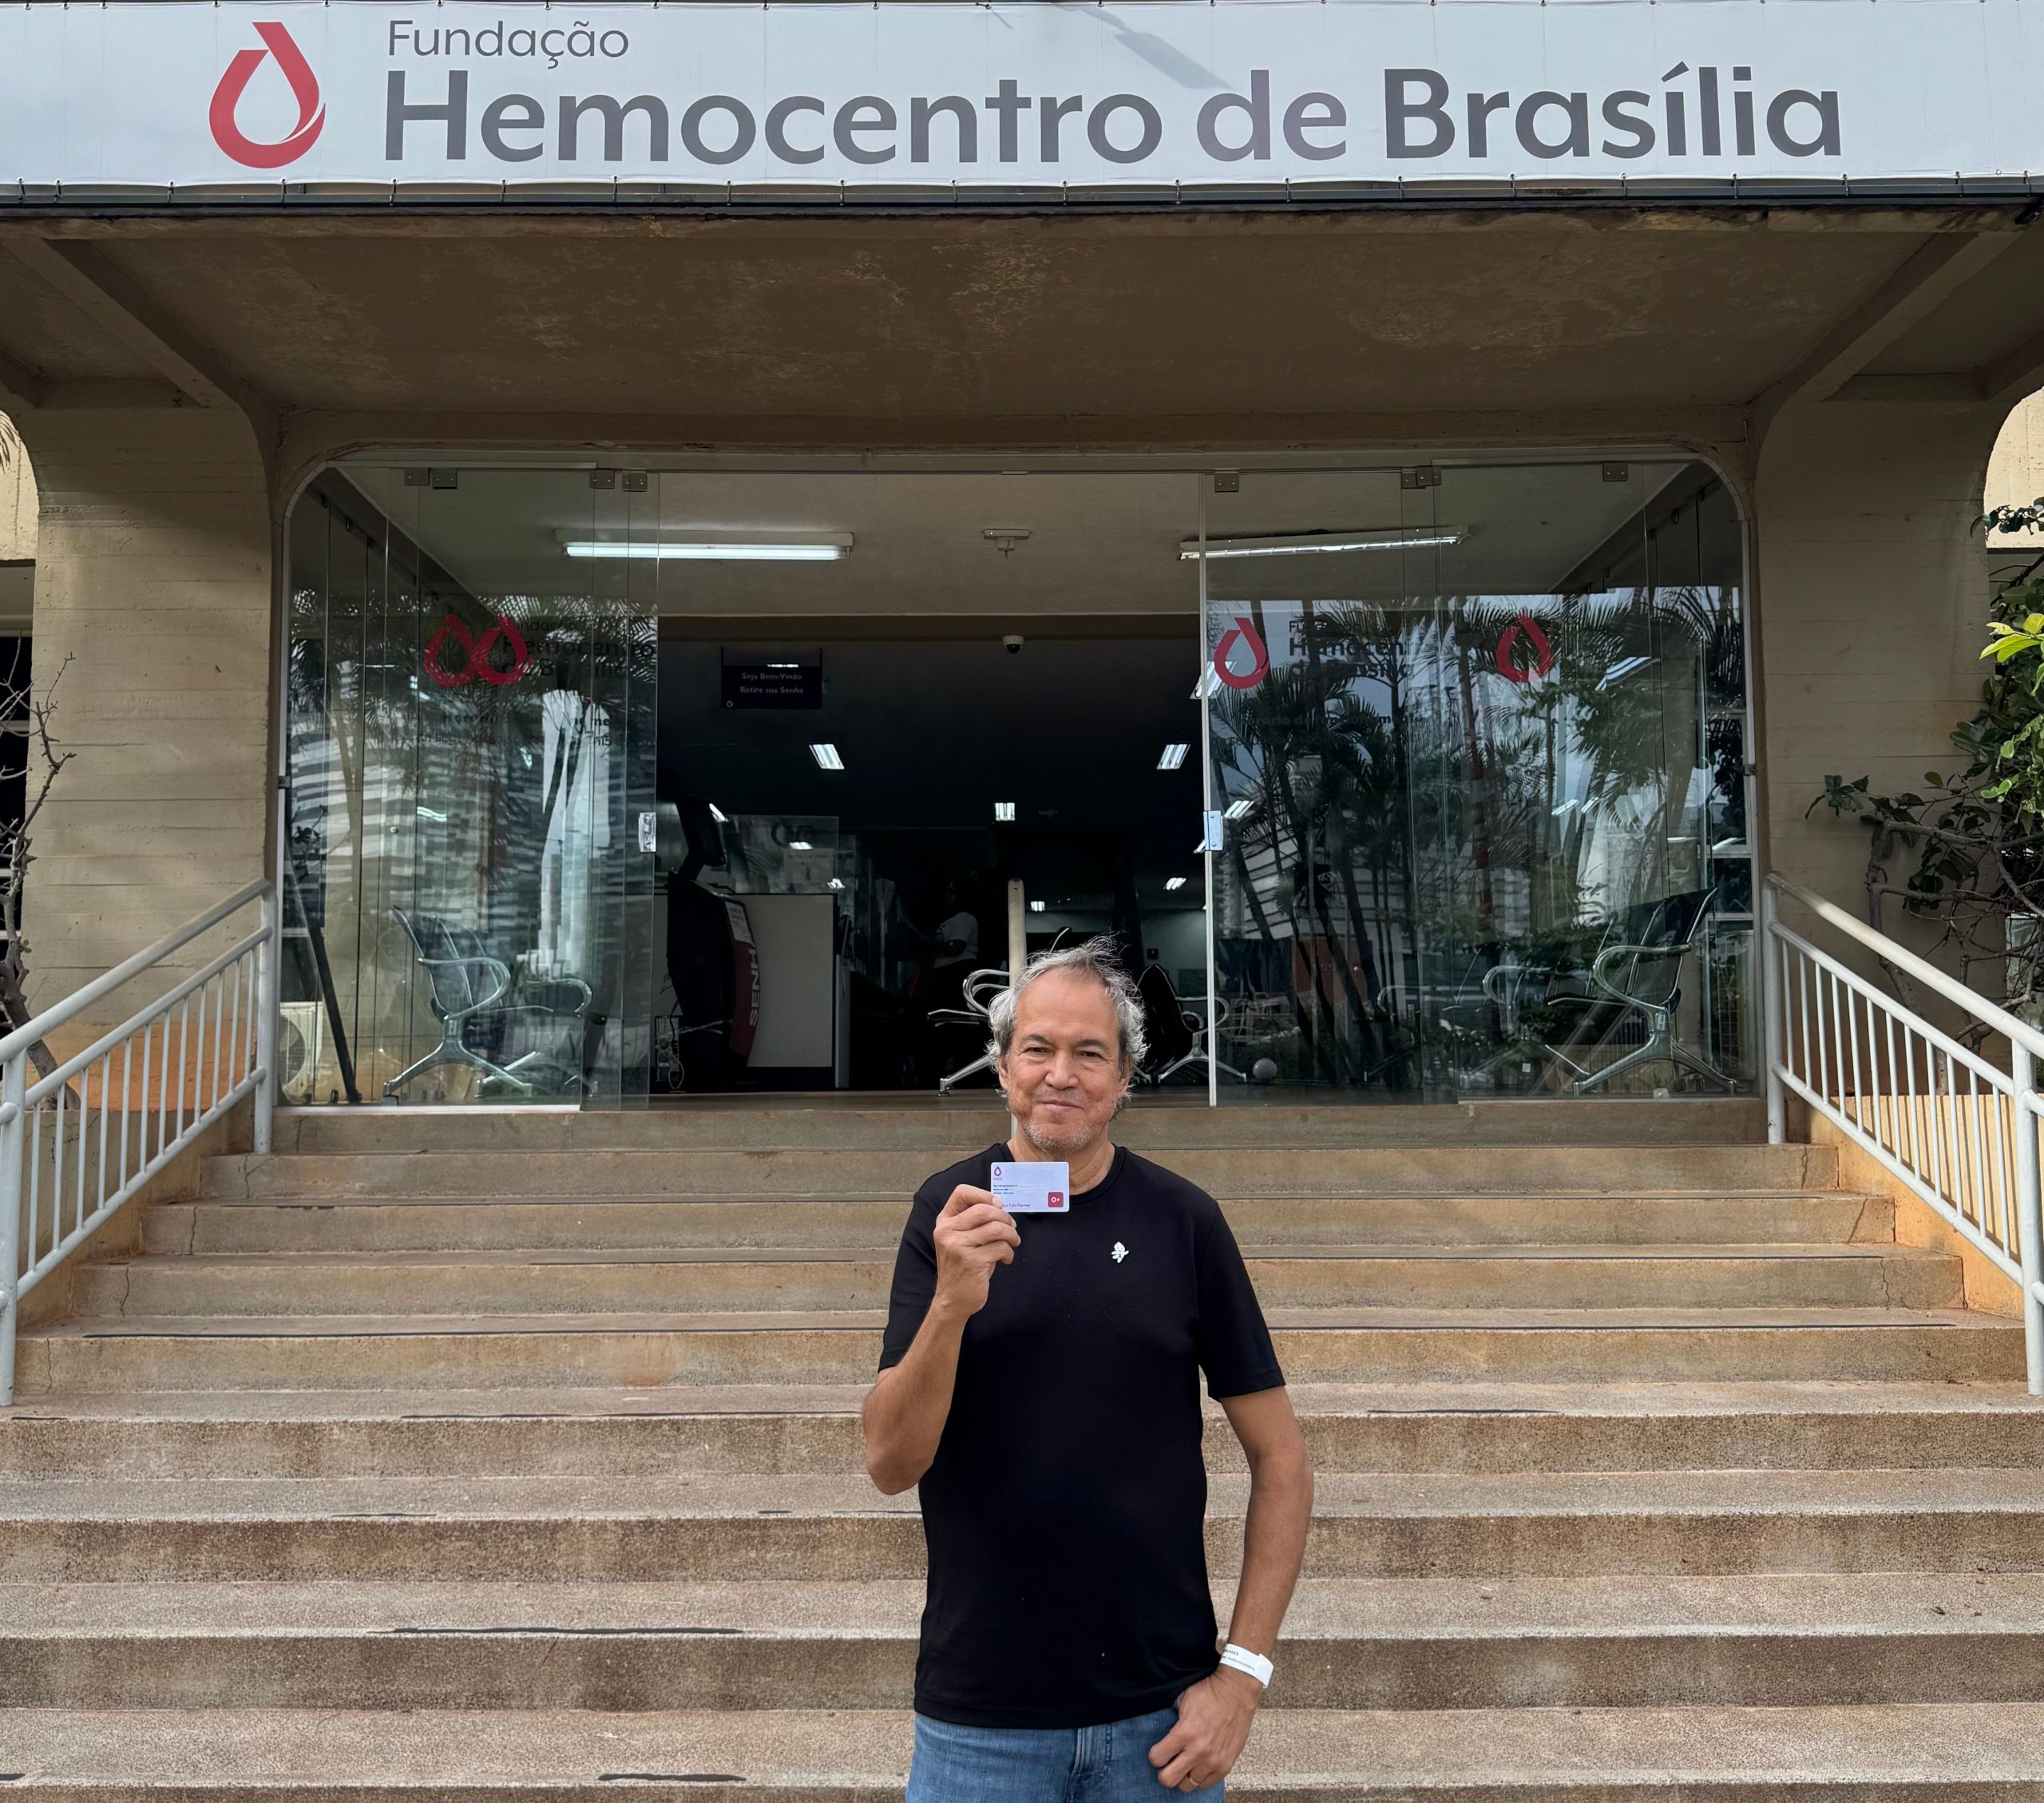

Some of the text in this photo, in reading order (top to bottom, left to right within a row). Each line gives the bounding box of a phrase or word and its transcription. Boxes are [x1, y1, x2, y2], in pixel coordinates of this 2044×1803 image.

[389, 21, 629, 69] Fundação
[386, 61, 1841, 165] Hemocentro de Brasília
[742, 672, 758, 681] Seja
[748, 947, 760, 1027] SENH
